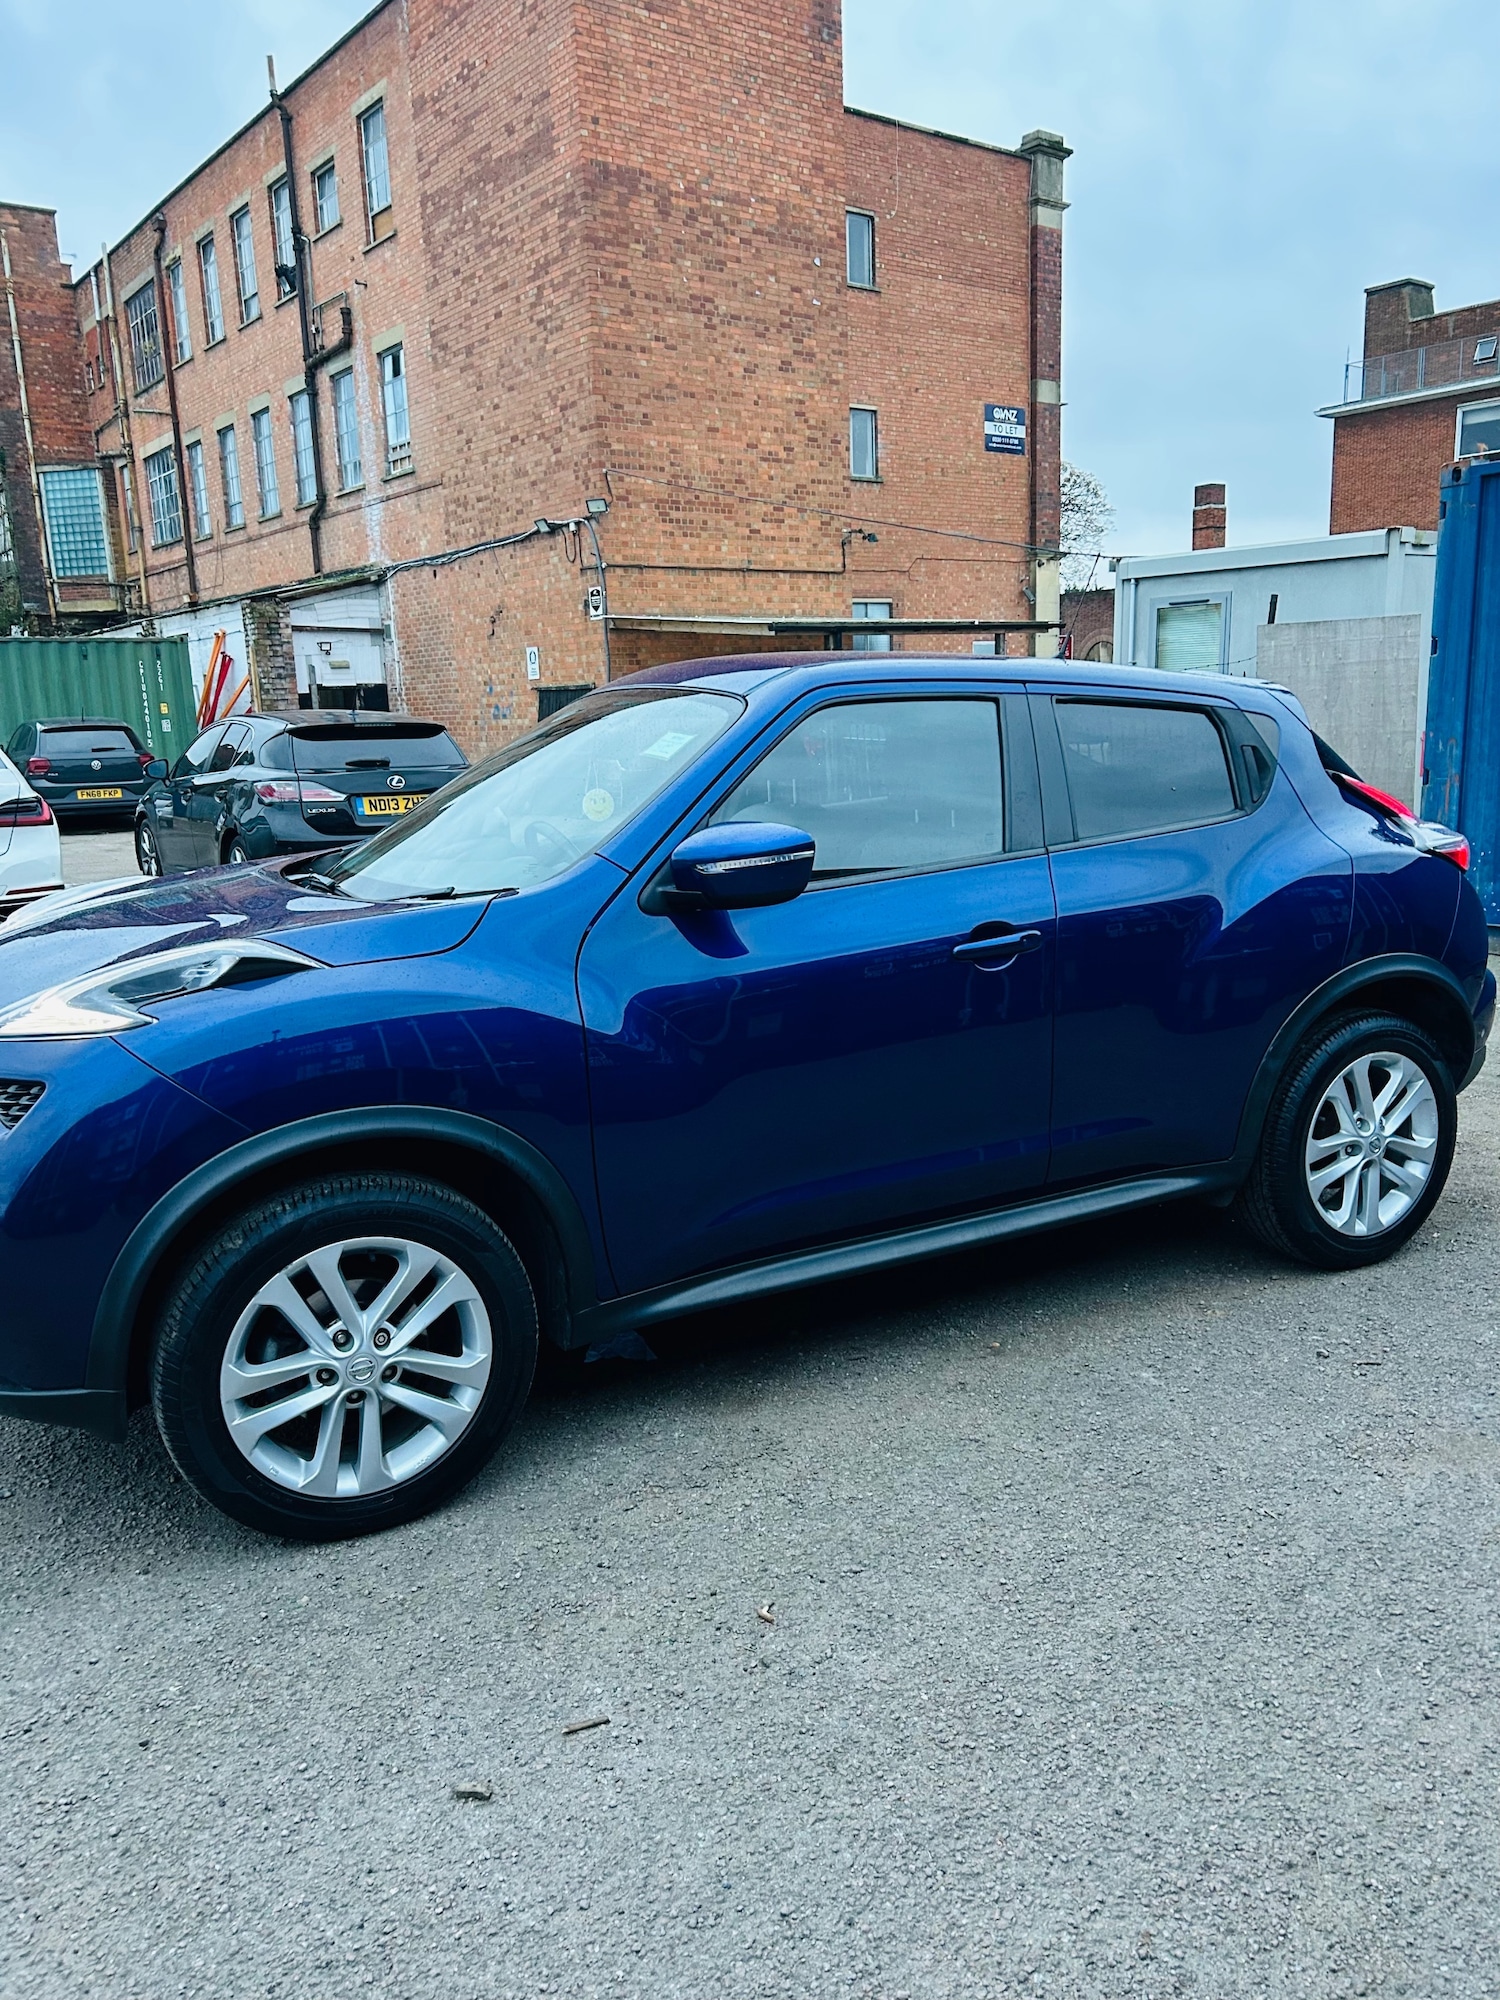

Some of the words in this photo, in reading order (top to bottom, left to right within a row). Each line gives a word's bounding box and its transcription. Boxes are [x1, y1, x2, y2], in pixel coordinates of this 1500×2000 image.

[993, 424, 1003, 433] TO
[1005, 425, 1018, 435] LET
[80, 789, 102, 798] FN68
[103, 789, 119, 797] FKP
[368, 798, 400, 812] ND13
[402, 796, 425, 810] ZH
